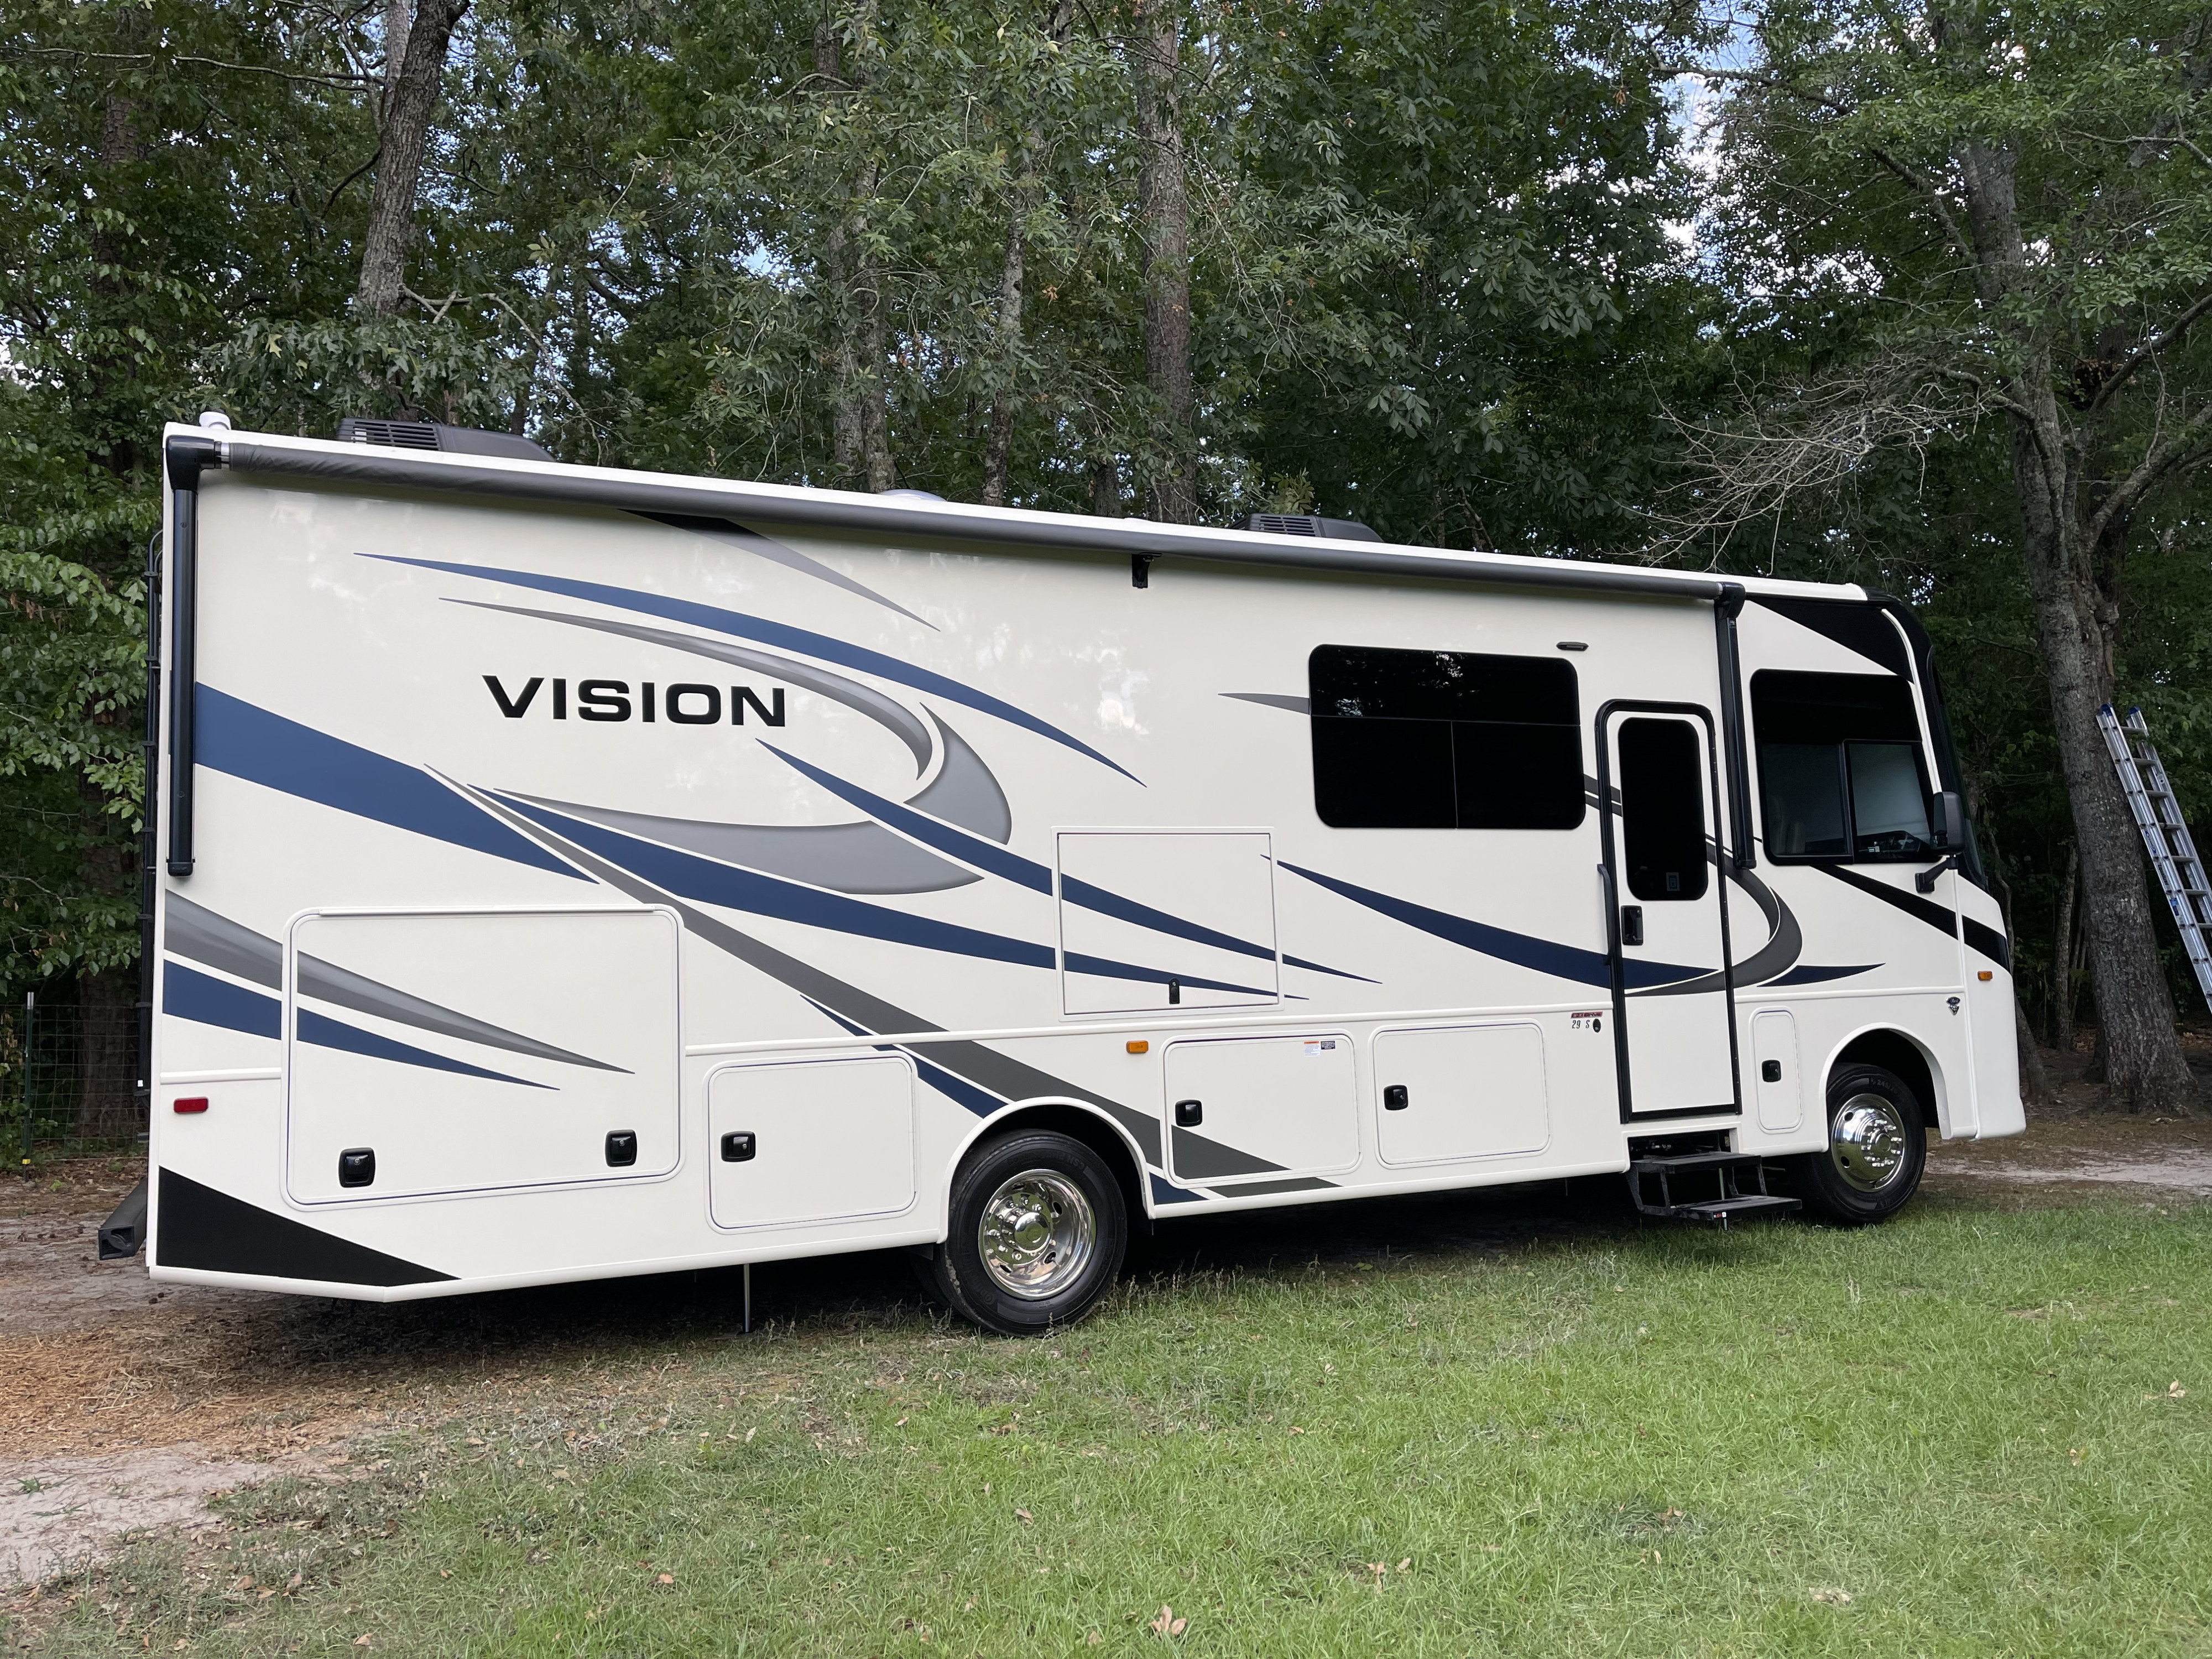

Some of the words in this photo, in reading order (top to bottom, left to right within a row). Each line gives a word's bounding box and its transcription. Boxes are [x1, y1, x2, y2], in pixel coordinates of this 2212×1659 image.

[482, 675, 785, 727] VISION
[1572, 1020, 1580, 1029] 29
[1585, 1020, 1590, 1029] S
